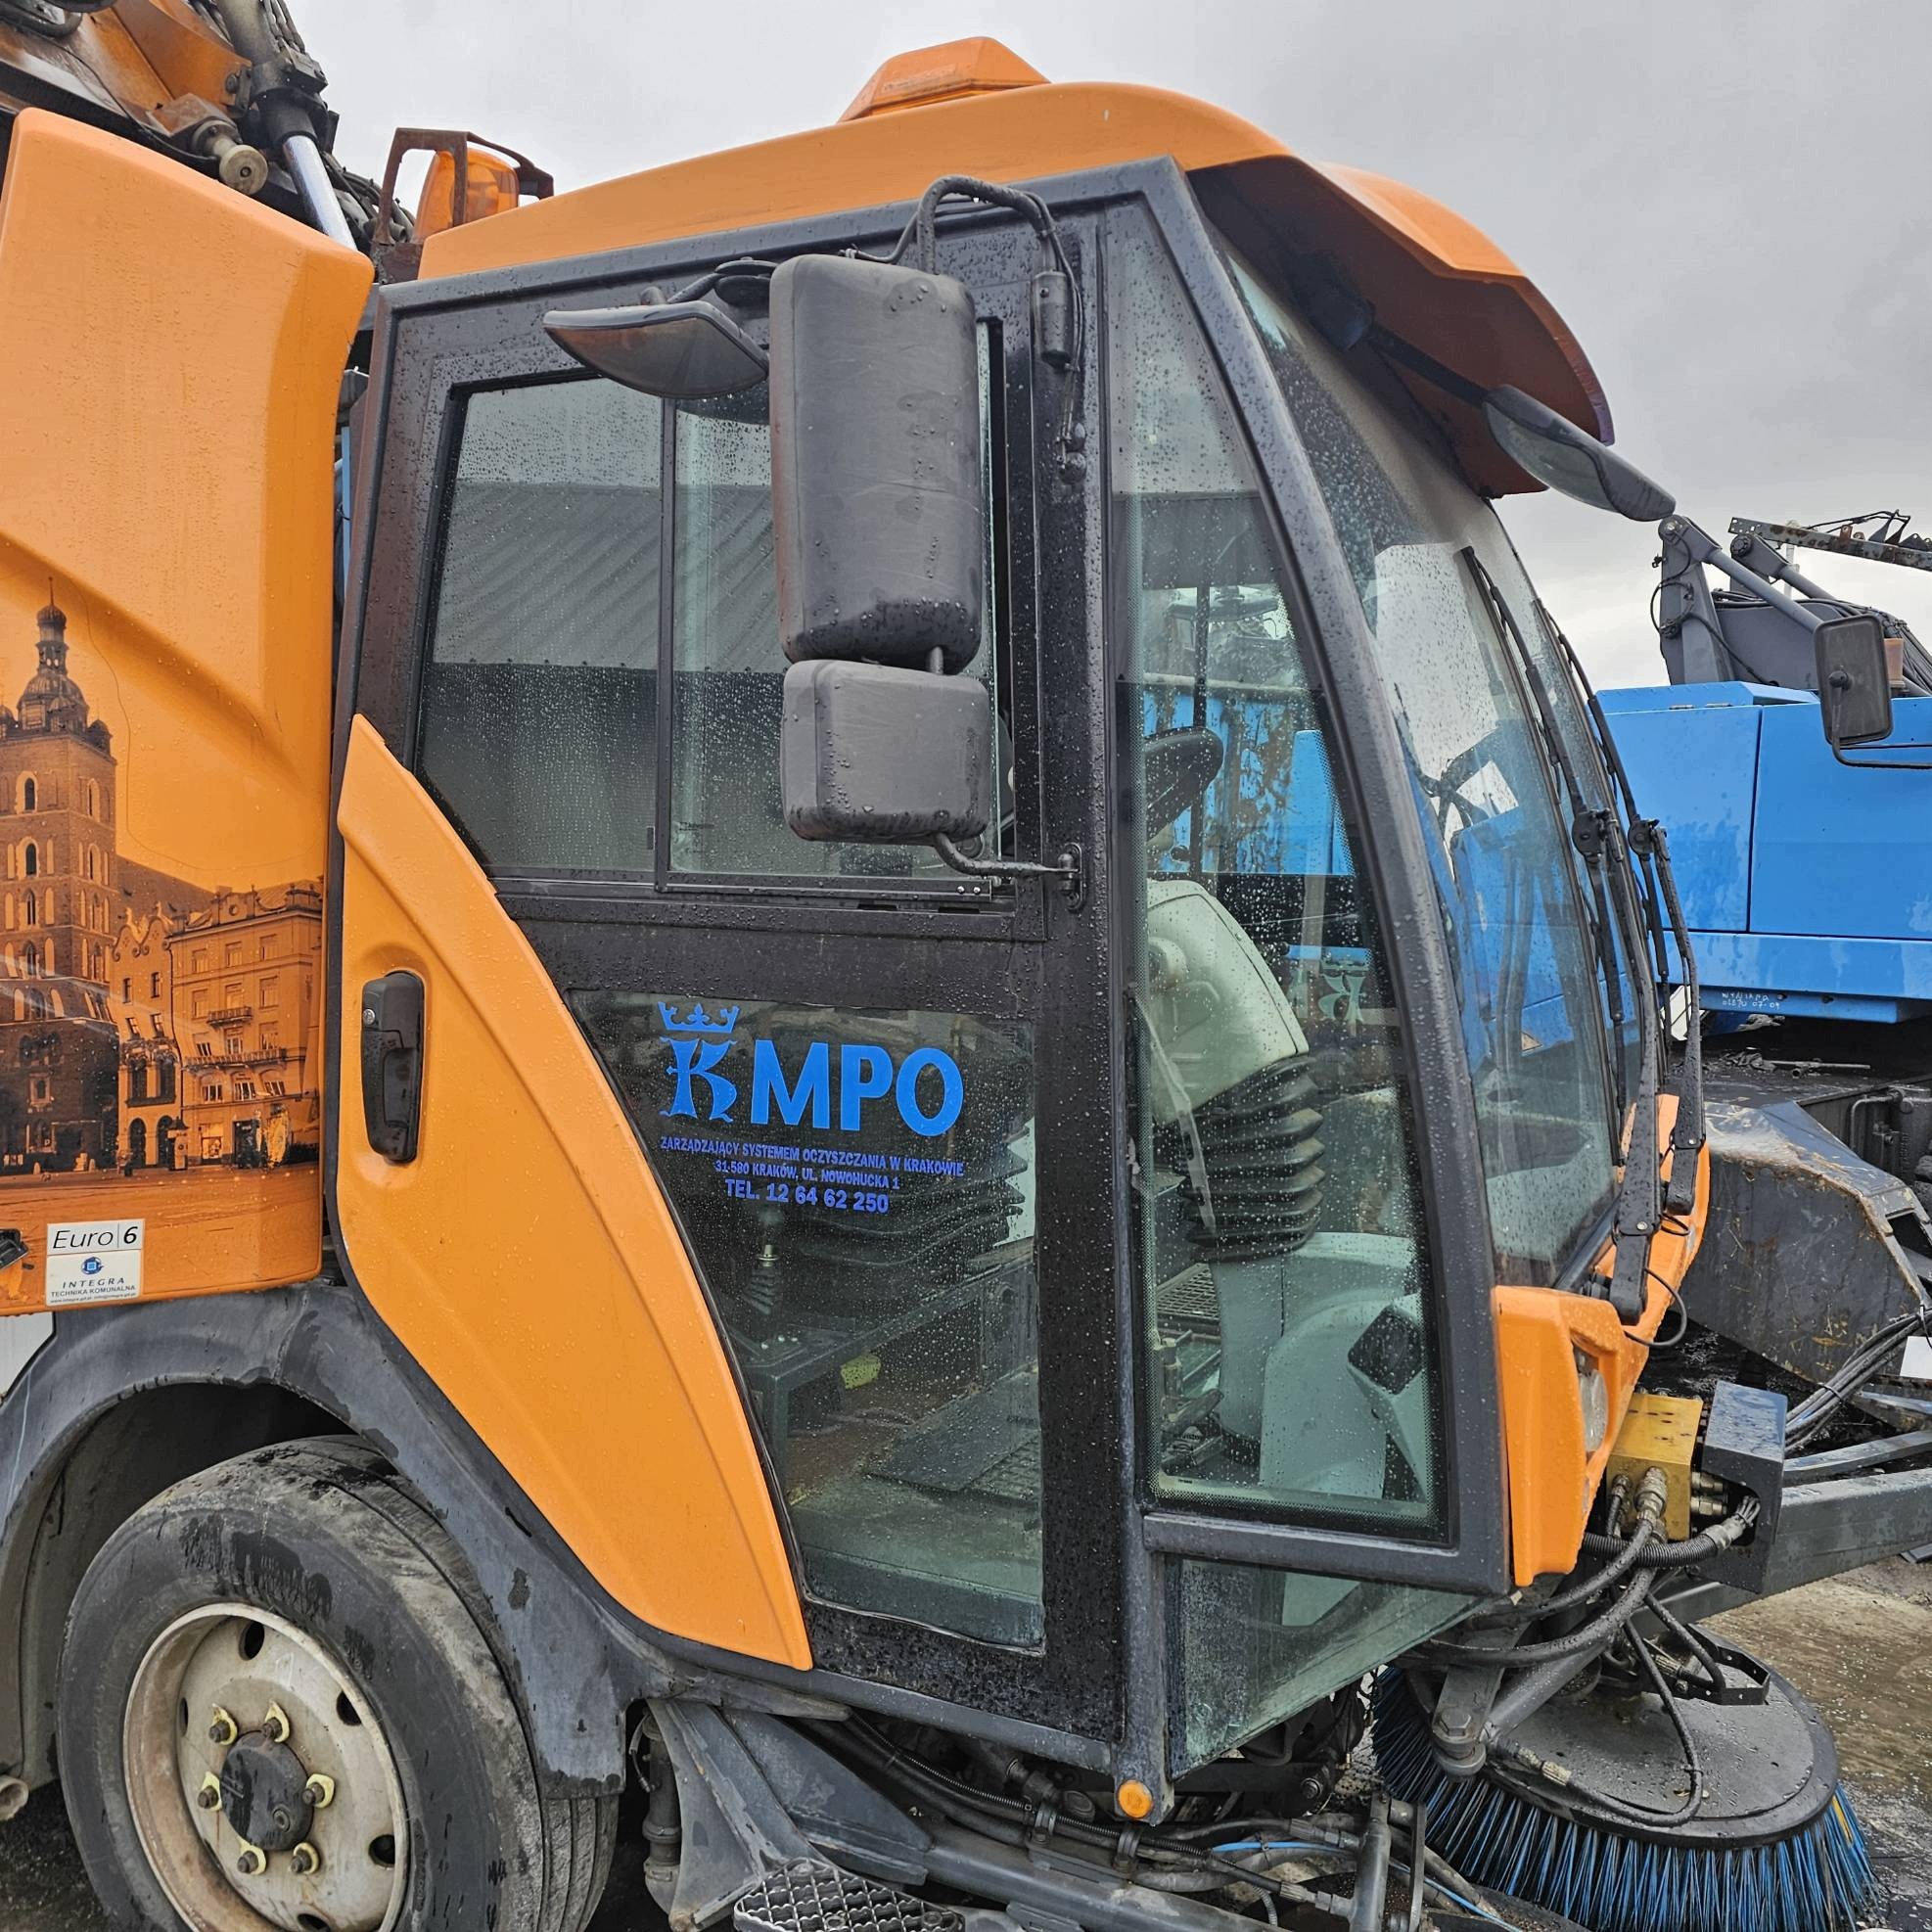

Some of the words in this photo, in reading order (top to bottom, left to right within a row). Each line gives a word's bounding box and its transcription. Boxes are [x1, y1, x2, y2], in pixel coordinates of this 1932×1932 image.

[751, 1039, 964, 1137] MPO
[742, 1143, 800, 1162] SYSTEMEM
[803, 1148, 887, 1170] OCZYSZCZANIA
[889, 1156, 900, 1172] W
[903, 1158, 964, 1177] KRAKOWIE
[802, 1167, 818, 1182] UL.
[821, 1169, 890, 1189] NOWOHUCKA
[892, 1176, 900, 1190] 1
[724, 1178, 760, 1200] TEL.
[766, 1182, 789, 1203] 12
[795, 1185, 818, 1206] 64
[823, 1188, 848, 1210] 62
[852, 1191, 890, 1214] 250
[52, 1229, 114, 1249] Euro
[123, 1225, 138, 1244] 6
[51, 1289, 88, 1298] TECHNIKA
[90, 1285, 136, 1294] KOMUNALNA
[63, 1276, 125, 1289] INTEGRA
